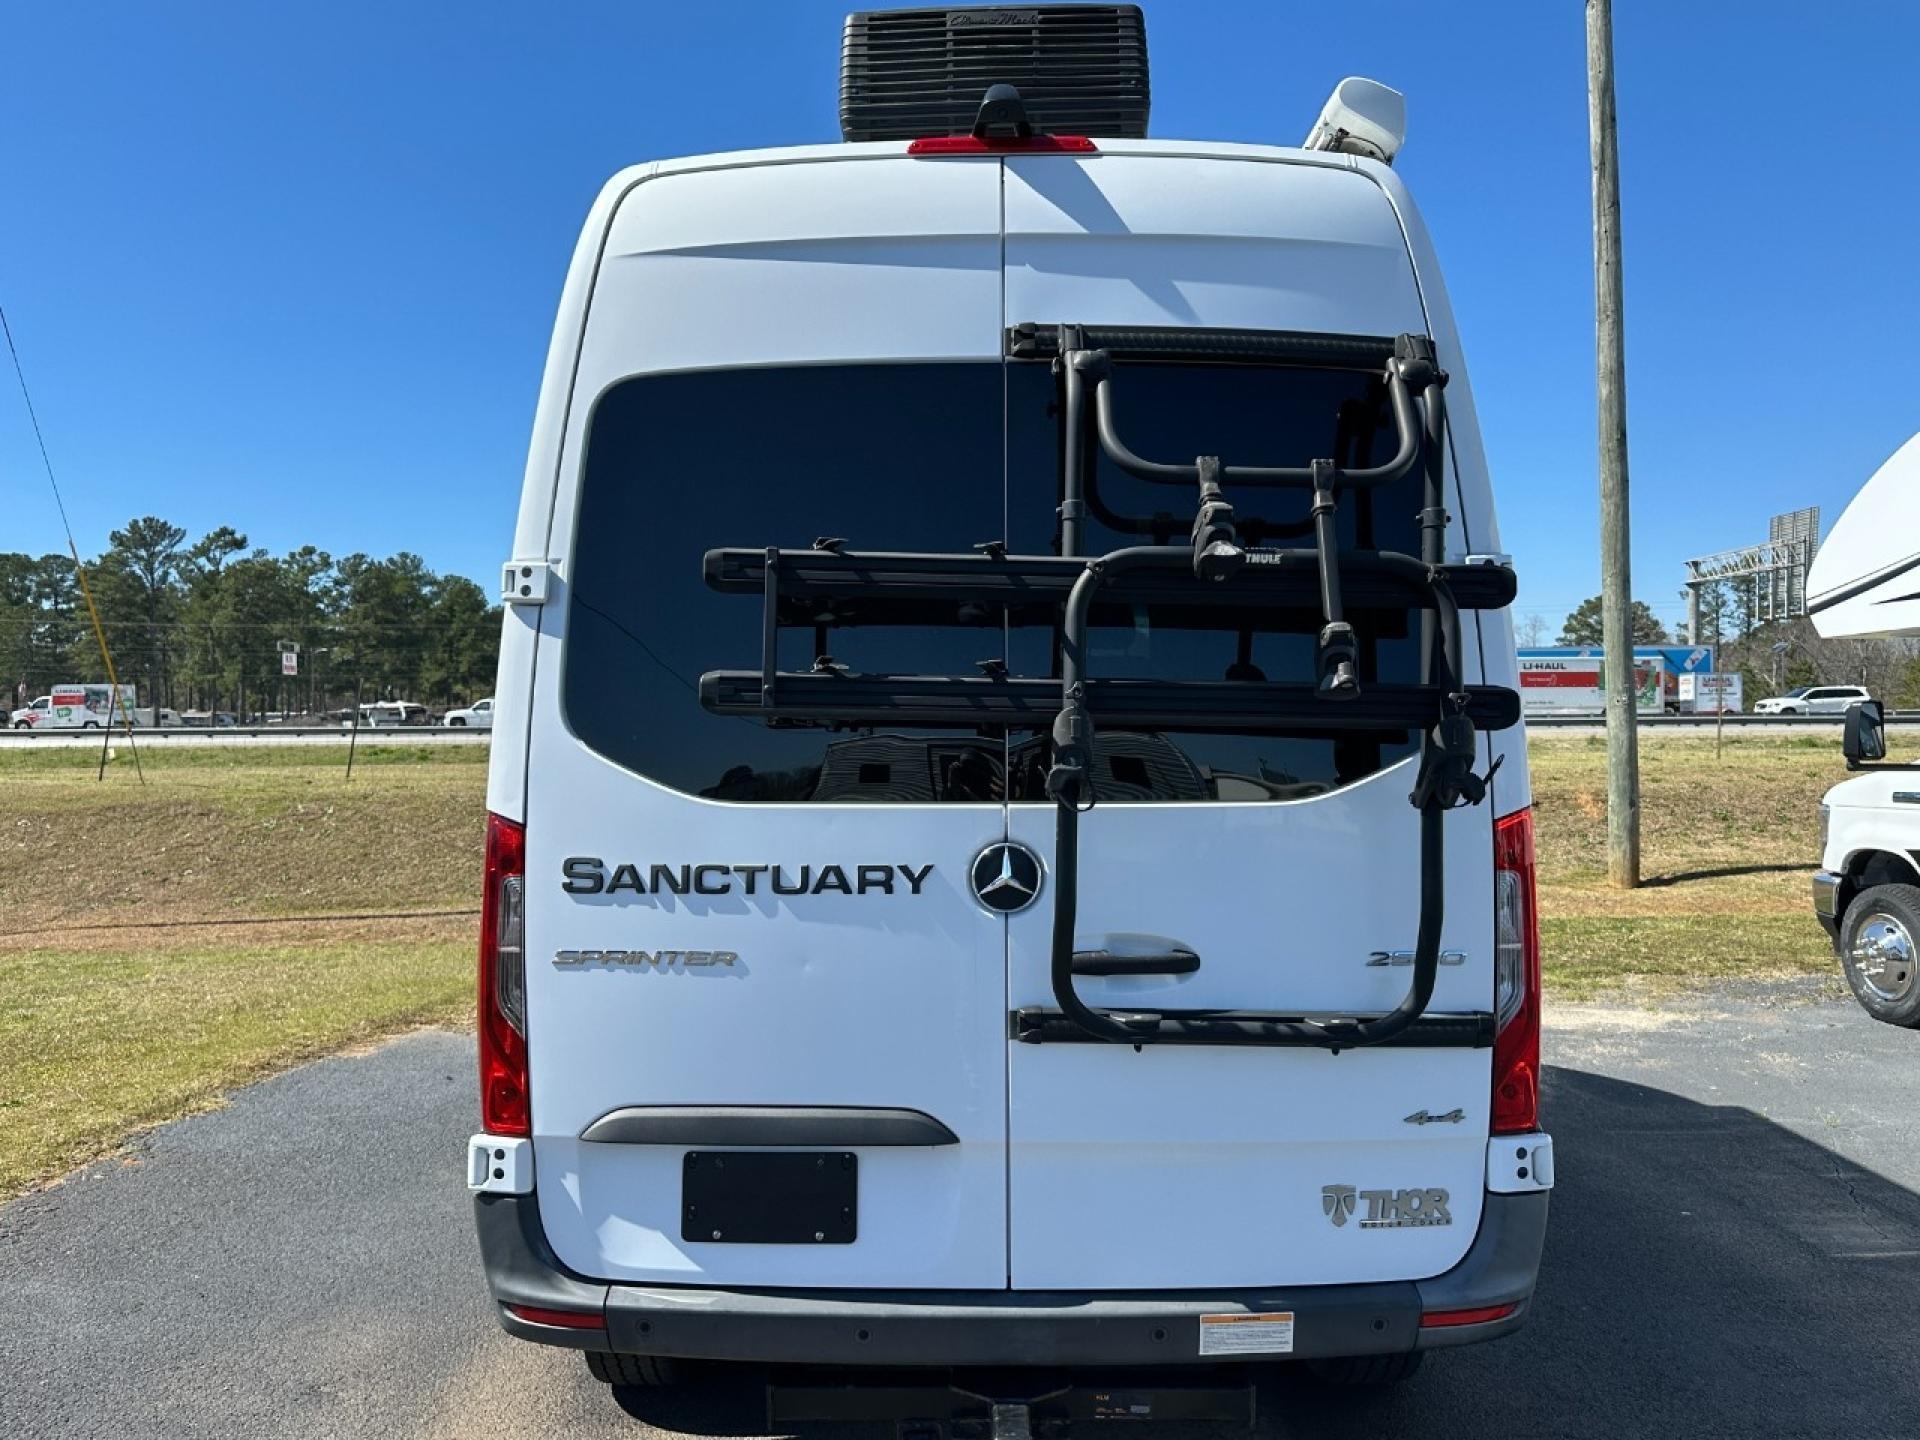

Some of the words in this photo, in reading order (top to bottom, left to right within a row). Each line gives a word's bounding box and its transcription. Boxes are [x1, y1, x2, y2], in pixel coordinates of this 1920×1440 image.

[1245, 553, 1281, 564] THULE
[1523, 662, 1567, 670] U-HAUL
[562, 856, 934, 895] SANCTUARY
[552, 950, 738, 967] SPRINTER
[1365, 951, 1468, 966] 250
[1359, 1188, 1452, 1218] THOR
[1360, 1220, 1403, 1228] MOTOR
[1410, 1218, 1452, 1226] COACH
